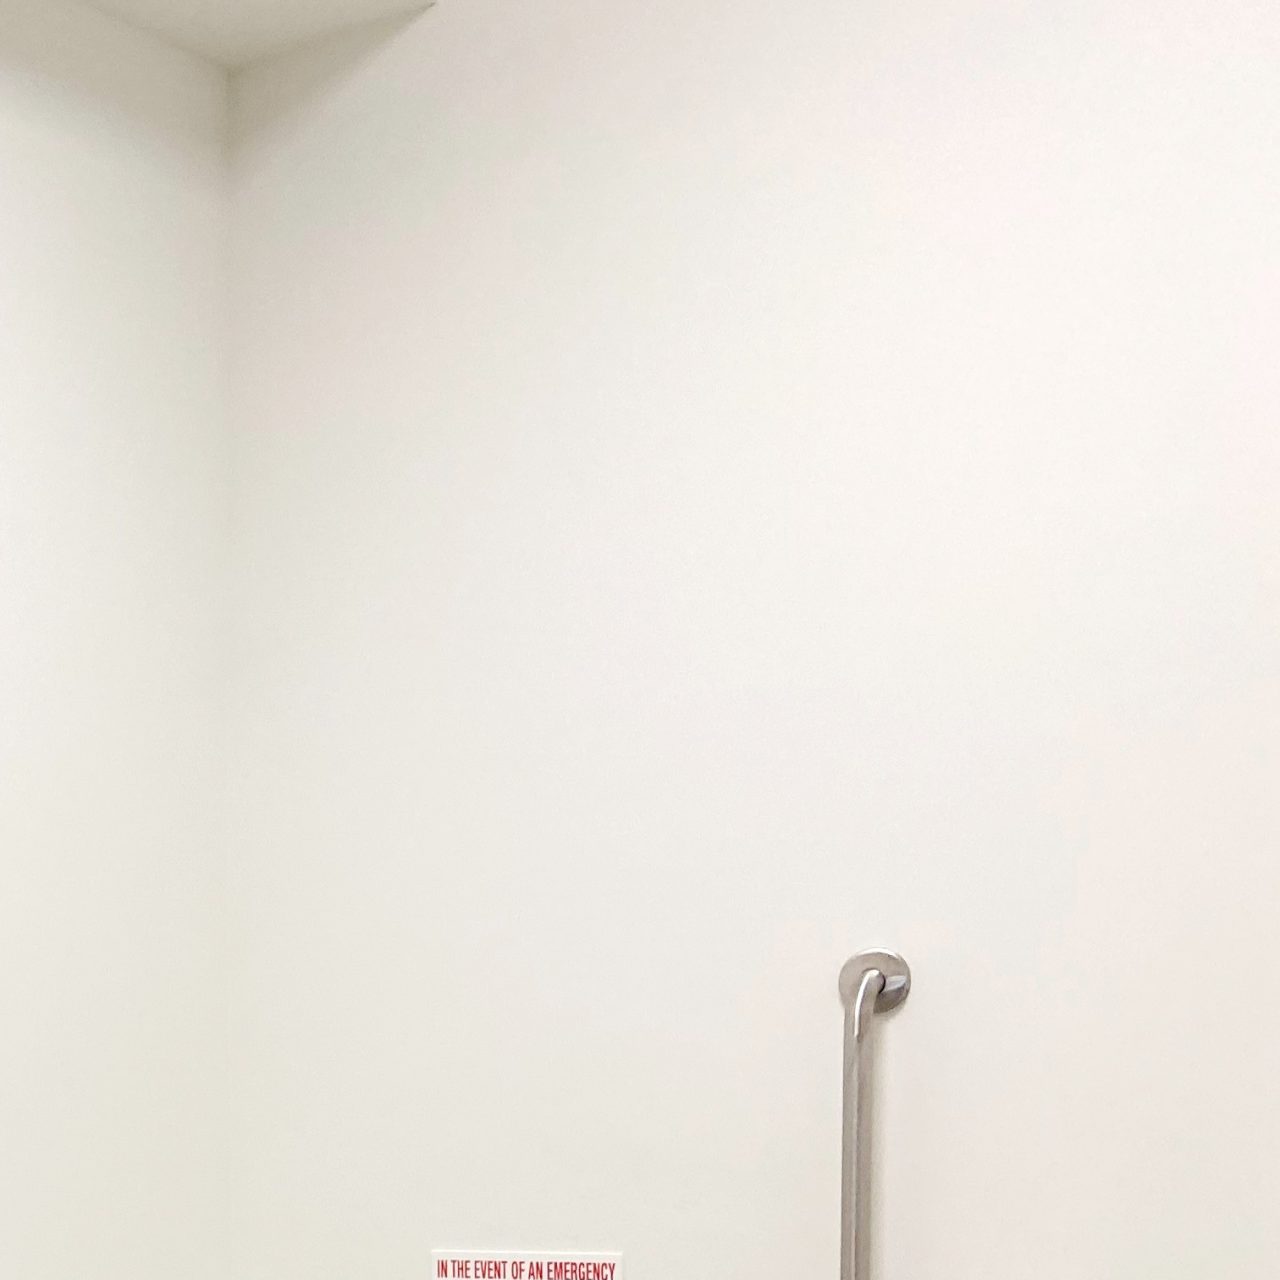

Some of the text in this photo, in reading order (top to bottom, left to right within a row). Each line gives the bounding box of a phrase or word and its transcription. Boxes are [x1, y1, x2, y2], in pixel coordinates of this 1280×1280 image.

[437, 1259, 448, 1278] IN
[451, 1259, 471, 1279] THE
[474, 1260, 508, 1279] EVENT
[511, 1260, 525, 1280] OF
[528, 1261, 543, 1280] AN
